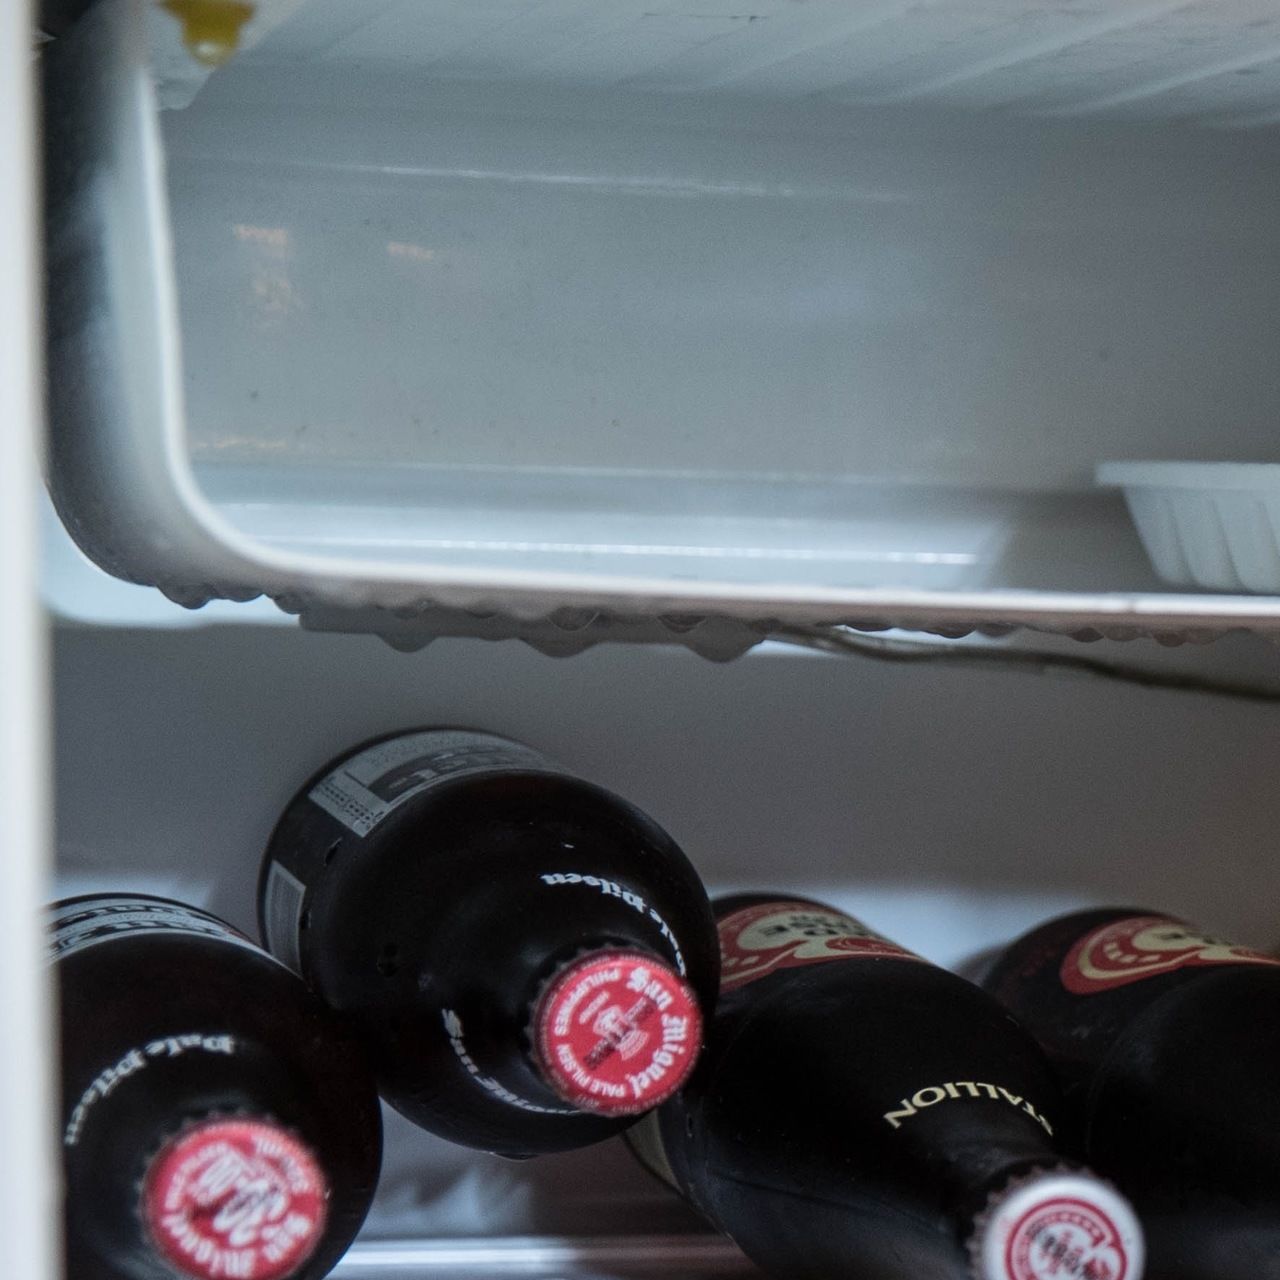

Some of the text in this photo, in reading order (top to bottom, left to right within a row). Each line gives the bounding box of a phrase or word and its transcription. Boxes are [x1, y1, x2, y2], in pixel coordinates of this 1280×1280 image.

[554, 967, 622, 1037] PHILIPPINES
[626, 966, 689, 1098] San Miguel
[556, 1043, 590, 1088] PILSEN
[588, 1078, 626, 1099] PALE
[882, 1080, 1053, 1137] STALLION
